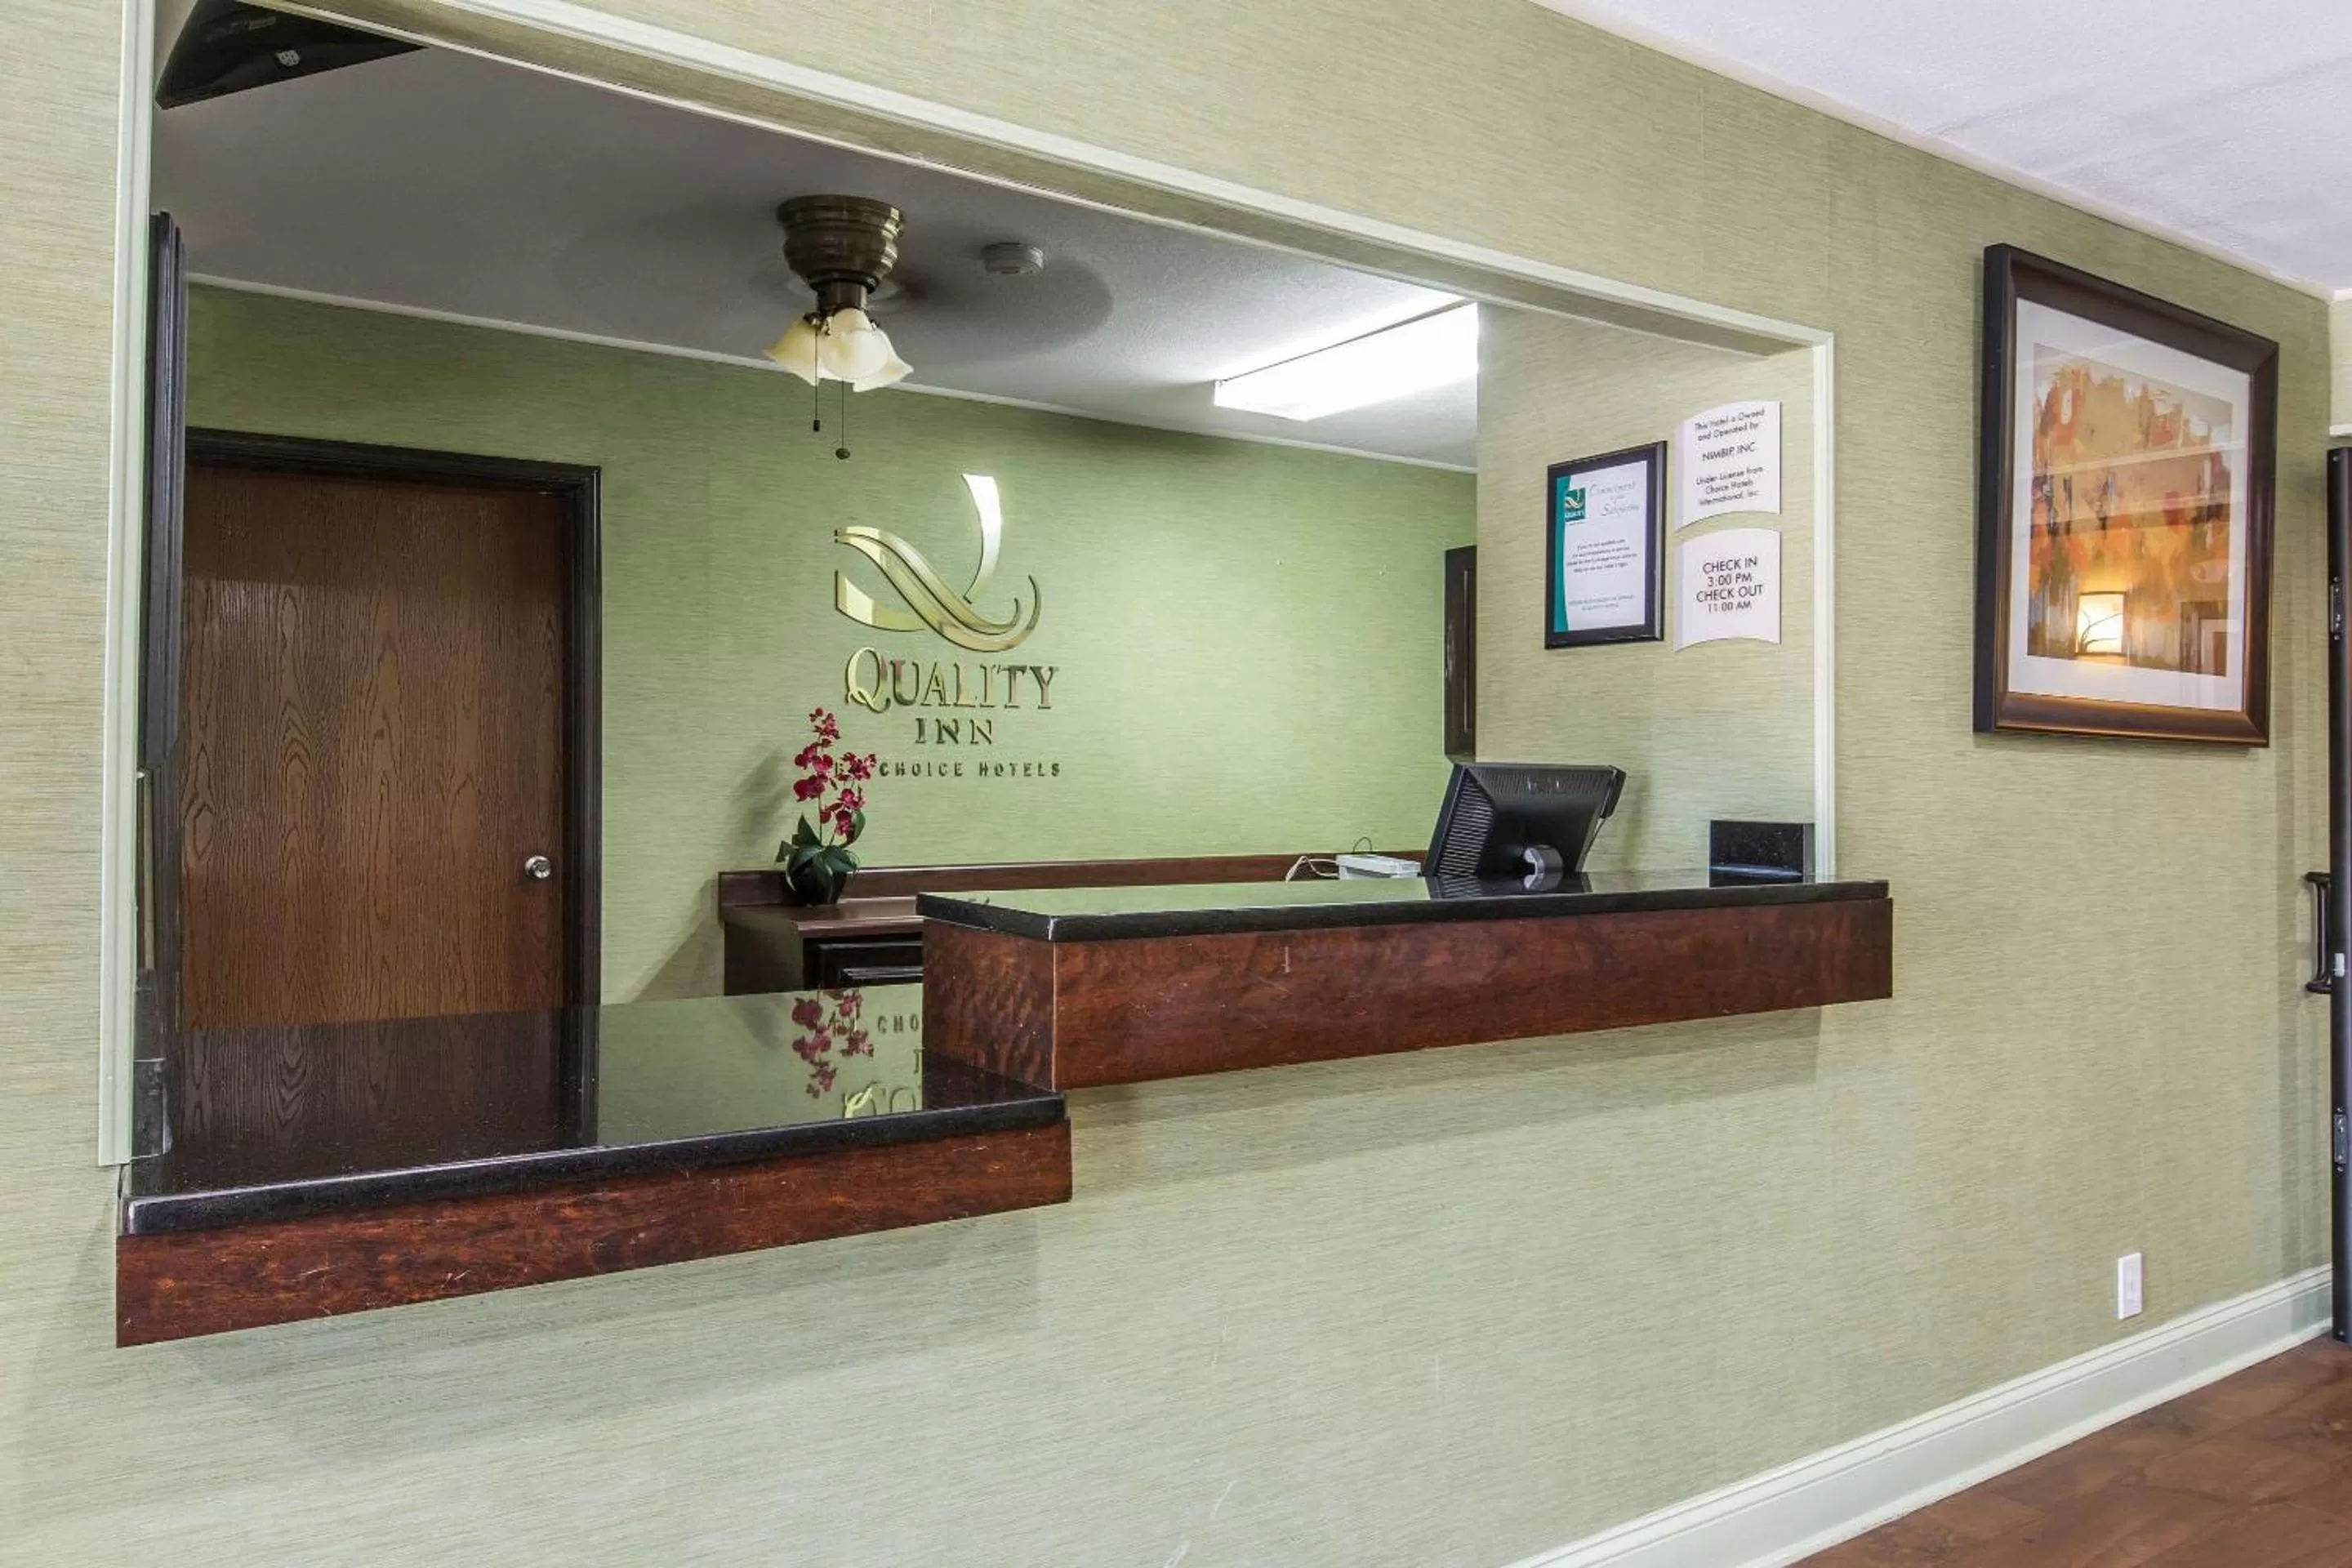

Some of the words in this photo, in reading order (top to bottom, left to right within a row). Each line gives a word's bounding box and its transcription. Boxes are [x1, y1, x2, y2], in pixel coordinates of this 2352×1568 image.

[1698, 431, 1711, 441] and
[1713, 422, 1748, 438] Operated
[1696, 476, 1717, 485] Under
[1719, 471, 1744, 480] License
[1705, 485, 1729, 494] Choice
[1703, 558, 1741, 574] CHECK
[1744, 556, 1757, 568] IN
[1708, 574, 1731, 587] 3:00
[1735, 572, 1753, 583] PM
[1696, 588, 1735, 603] CHECK
[1738, 585, 1763, 598] OUT
[1736, 600, 1752, 610] AM
[844, 647, 1060, 713] QUALITY
[915, 717, 993, 745] INN
[879, 762, 964, 777] CHOICE
[979, 762, 1061, 777] HOTELS
